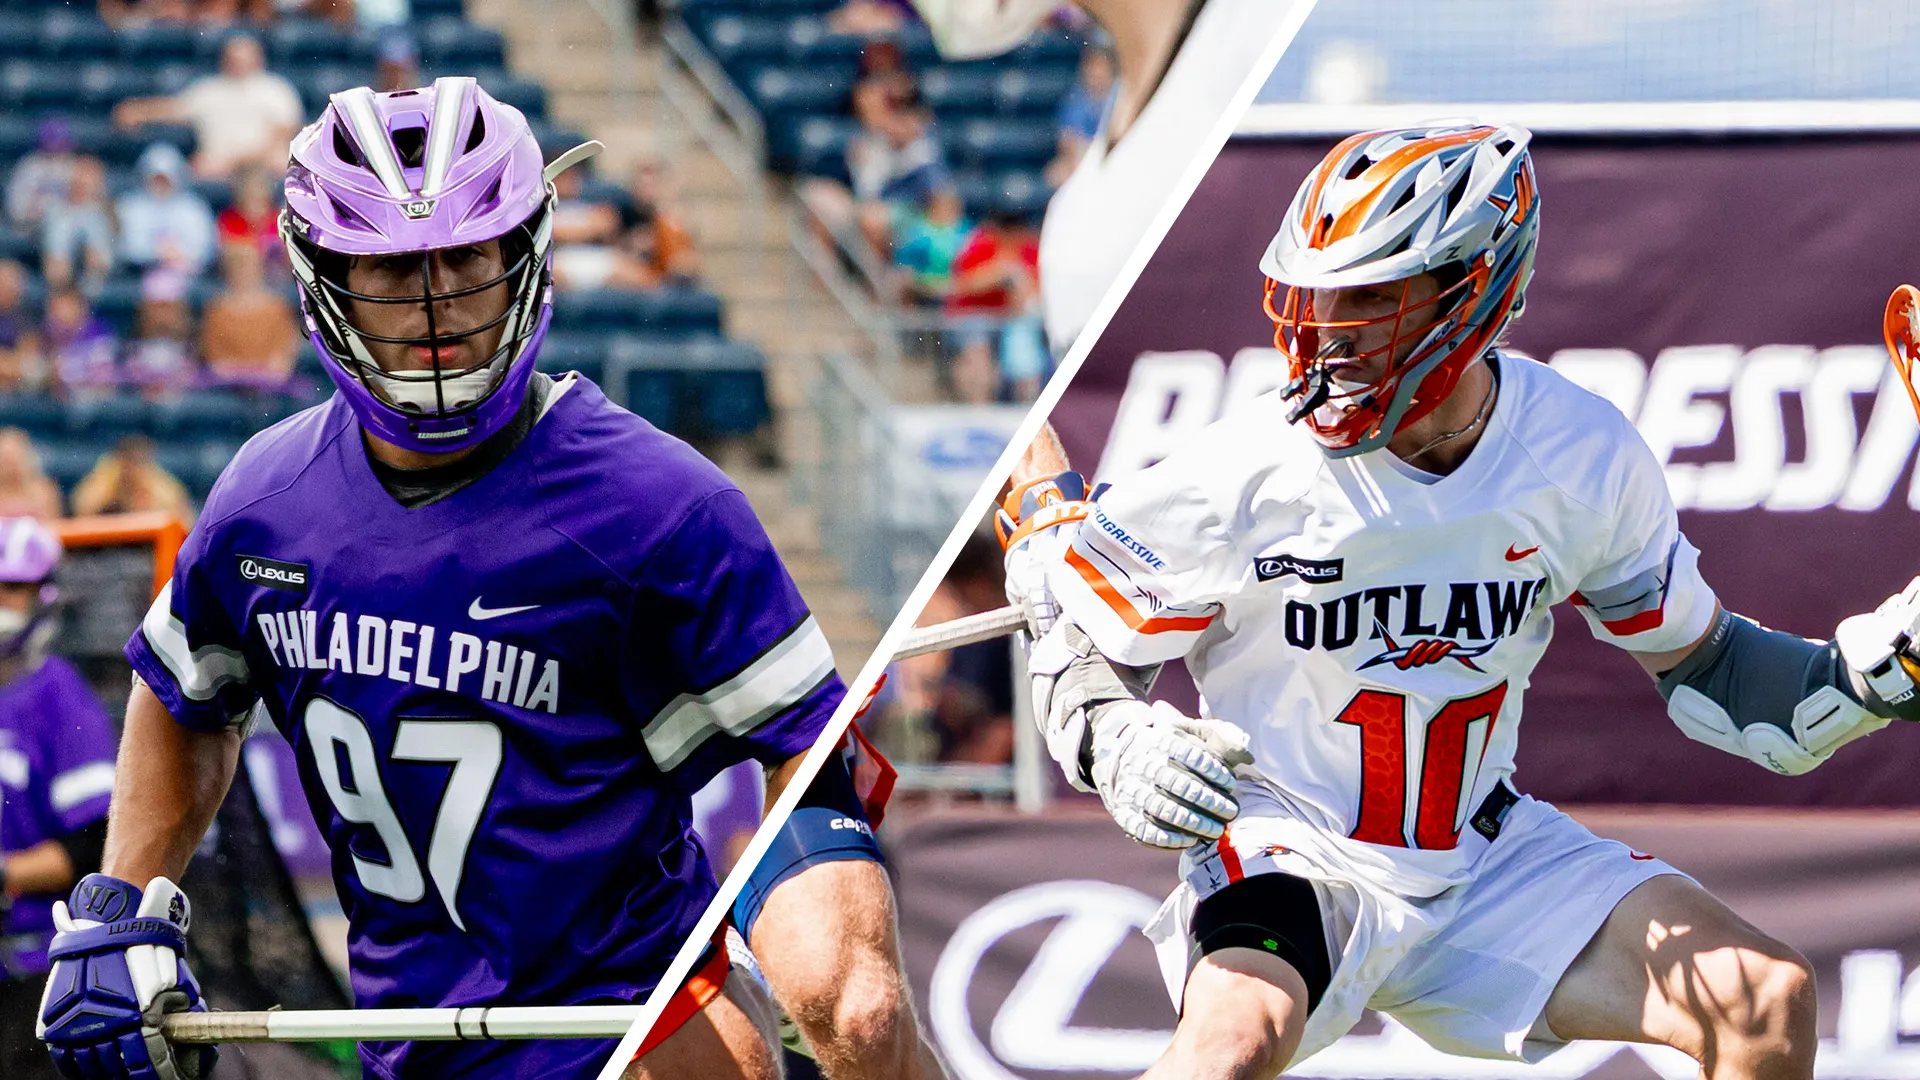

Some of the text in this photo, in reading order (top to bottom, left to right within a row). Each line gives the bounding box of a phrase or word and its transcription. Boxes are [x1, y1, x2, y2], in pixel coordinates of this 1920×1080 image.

[258, 566, 306, 584] LEXUS
[256, 609, 560, 714] PHILADELPHIA
[304, 697, 502, 932] 97
[1332, 678, 1509, 850] 10
